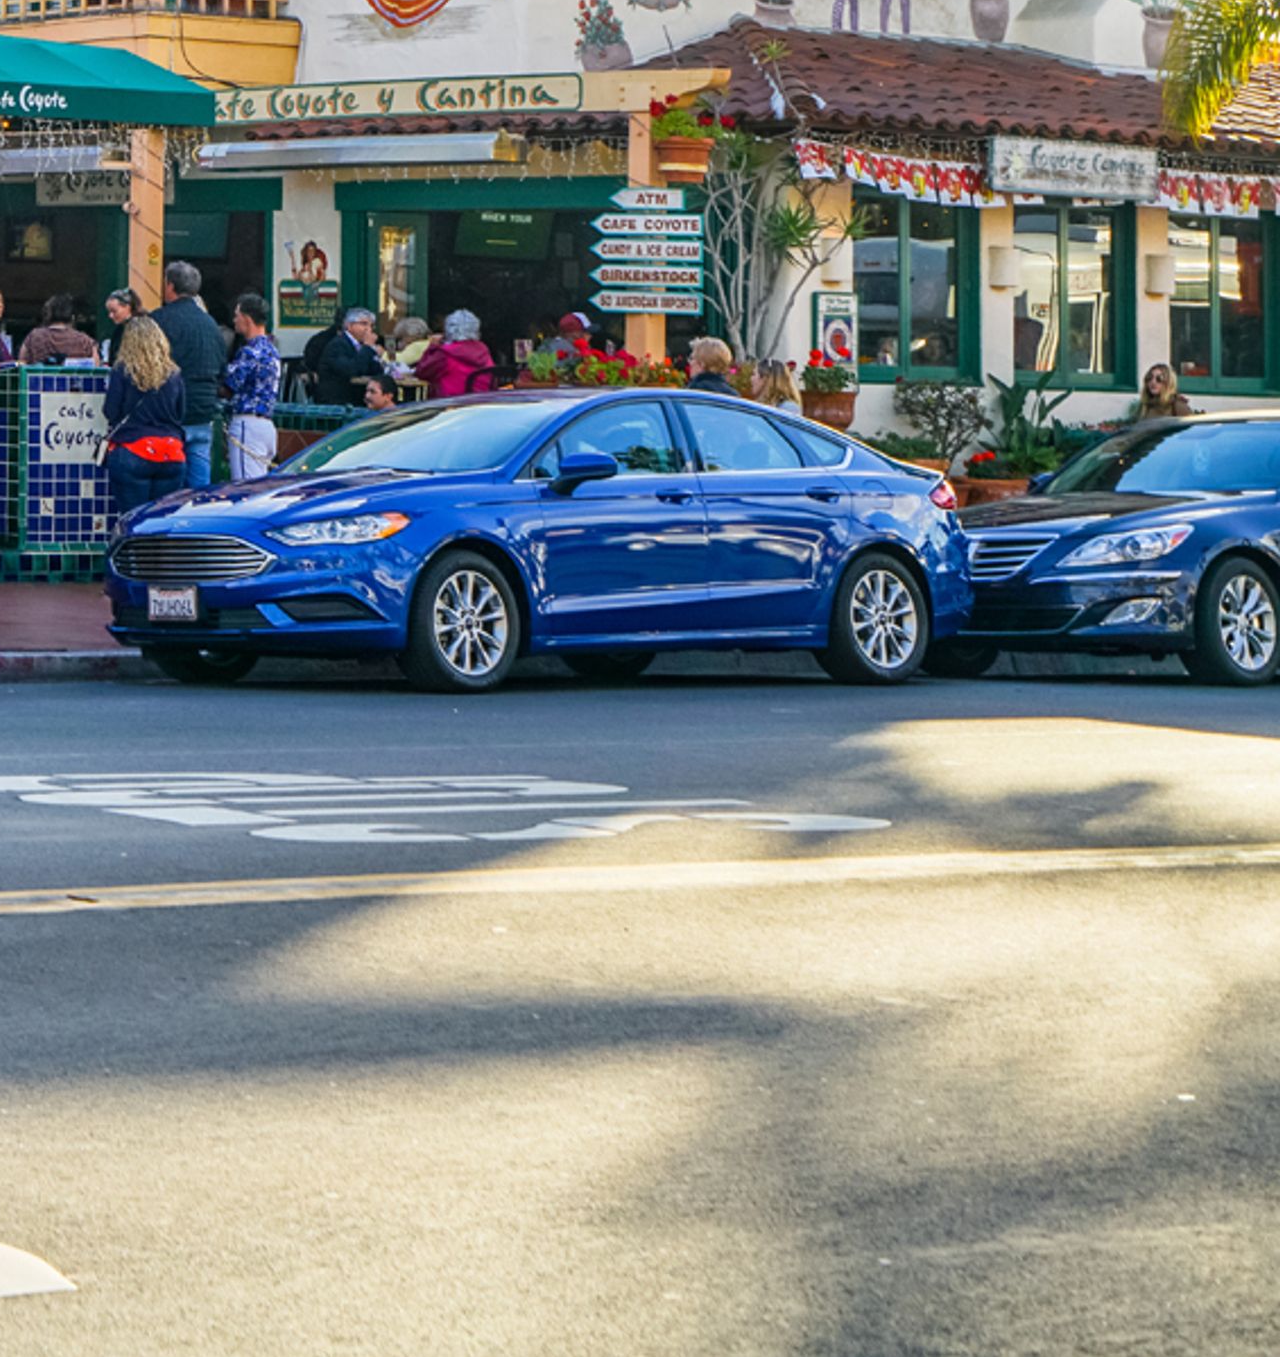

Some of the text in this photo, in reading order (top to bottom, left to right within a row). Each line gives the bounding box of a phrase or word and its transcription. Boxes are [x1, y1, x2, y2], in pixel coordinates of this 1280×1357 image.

[19, 85, 68, 113] Coyote
[214, 79, 559, 121] afe Coyote y Cantina
[635, 193, 668, 205] ATM
[601, 218, 699, 232] CAFE COYOTE
[647, 244, 662, 256] ICE
[665, 245, 699, 257] CREAM
[601, 269, 698, 283] BIRKENSTOCK
[615, 295, 658, 309] AMERICAN
[58, 402, 95, 420] cafe
